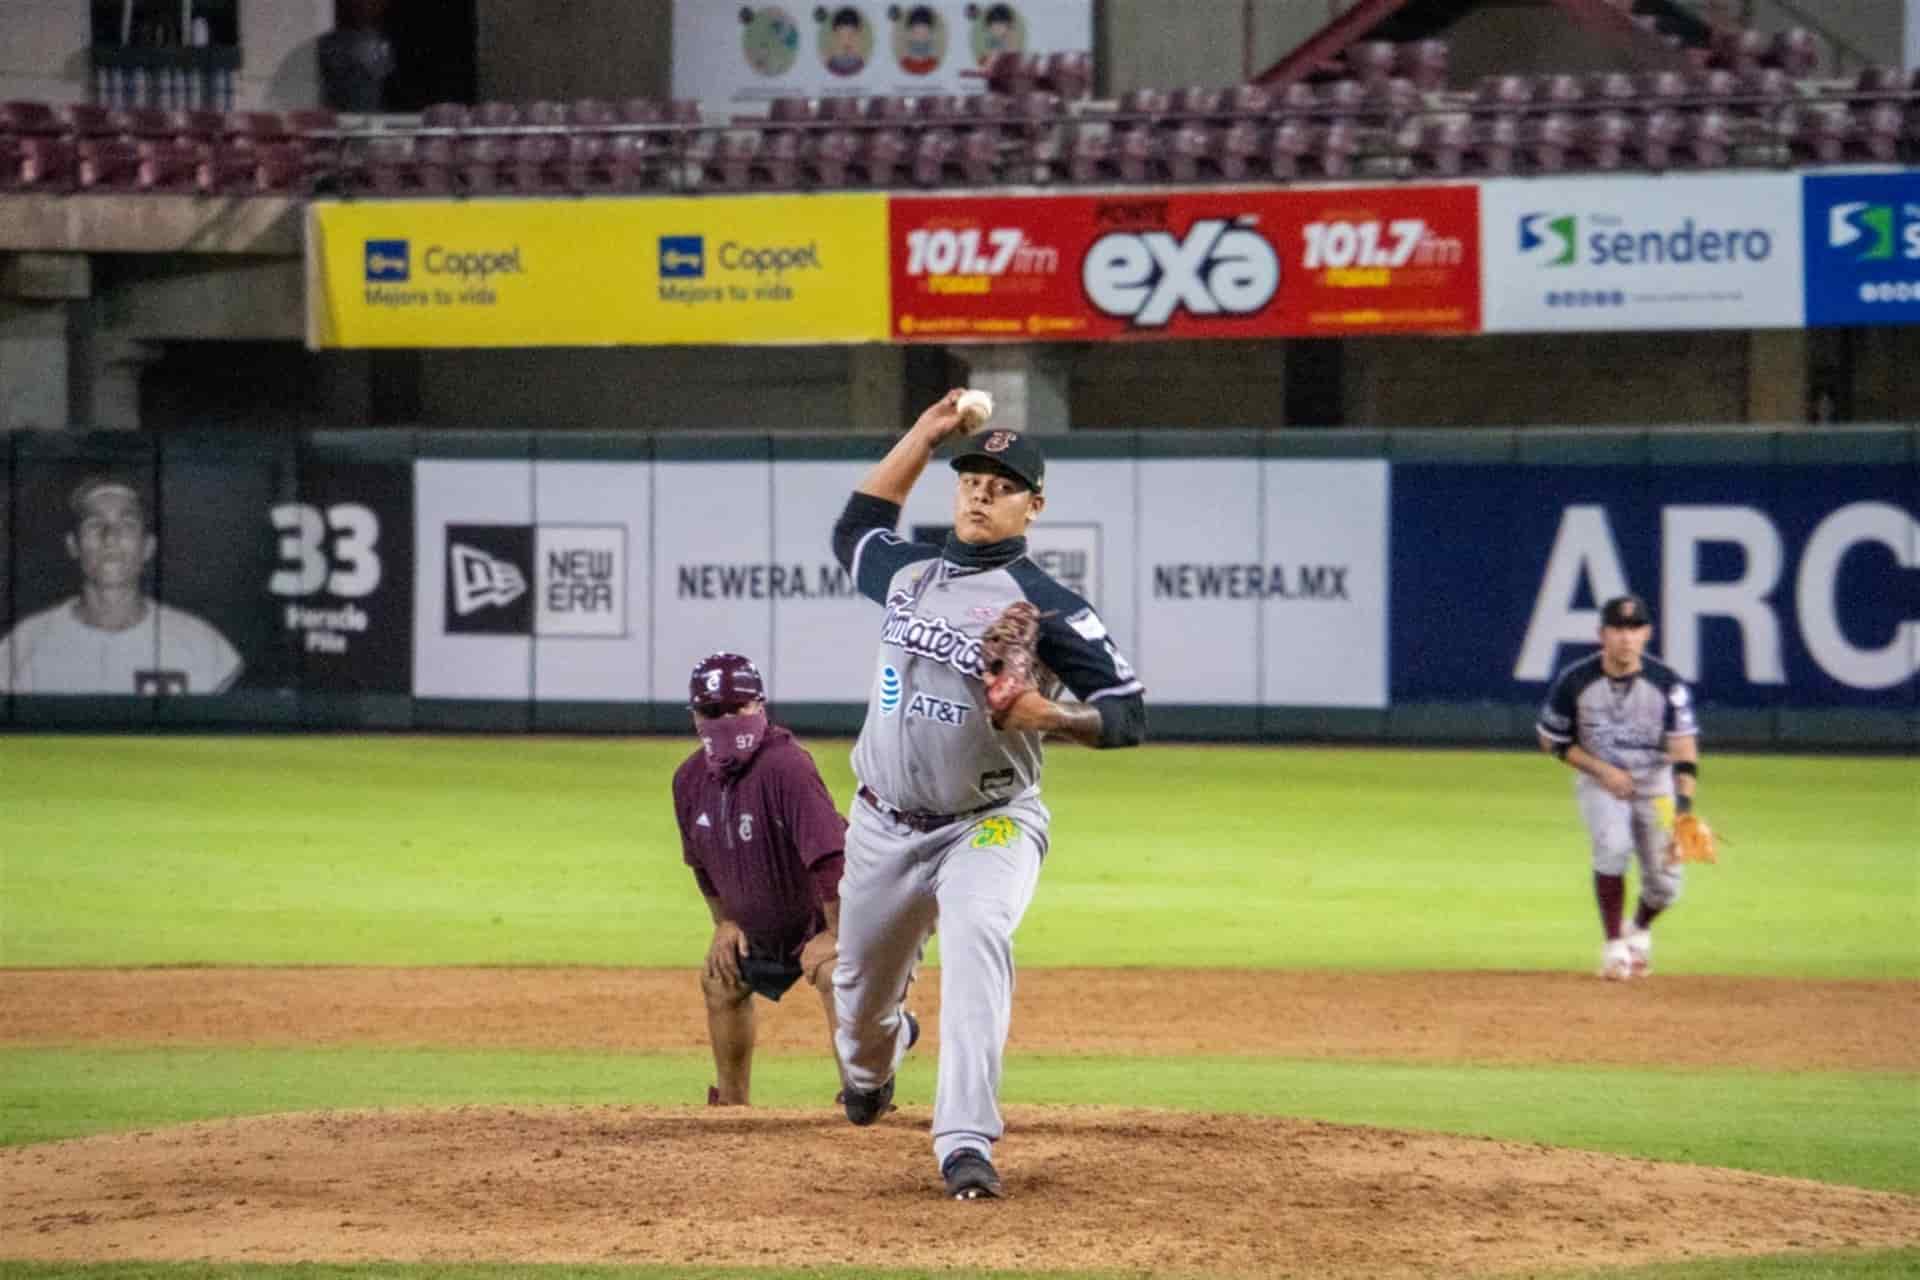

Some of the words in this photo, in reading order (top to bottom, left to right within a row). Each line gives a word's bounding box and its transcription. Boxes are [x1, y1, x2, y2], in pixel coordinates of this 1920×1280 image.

[718, 240, 822, 276] Coppel
[1589, 218, 1772, 266] sendero
[424, 245, 525, 280] Coppel
[268, 502, 382, 597] 33
[547, 549, 614, 579] NEW
[547, 582, 613, 612] ERA
[1154, 564, 1350, 600] NEWERA.MX
[1512, 502, 1920, 690] ARC
[908, 693, 972, 726] AT&T
[735, 733, 755, 750] 97
